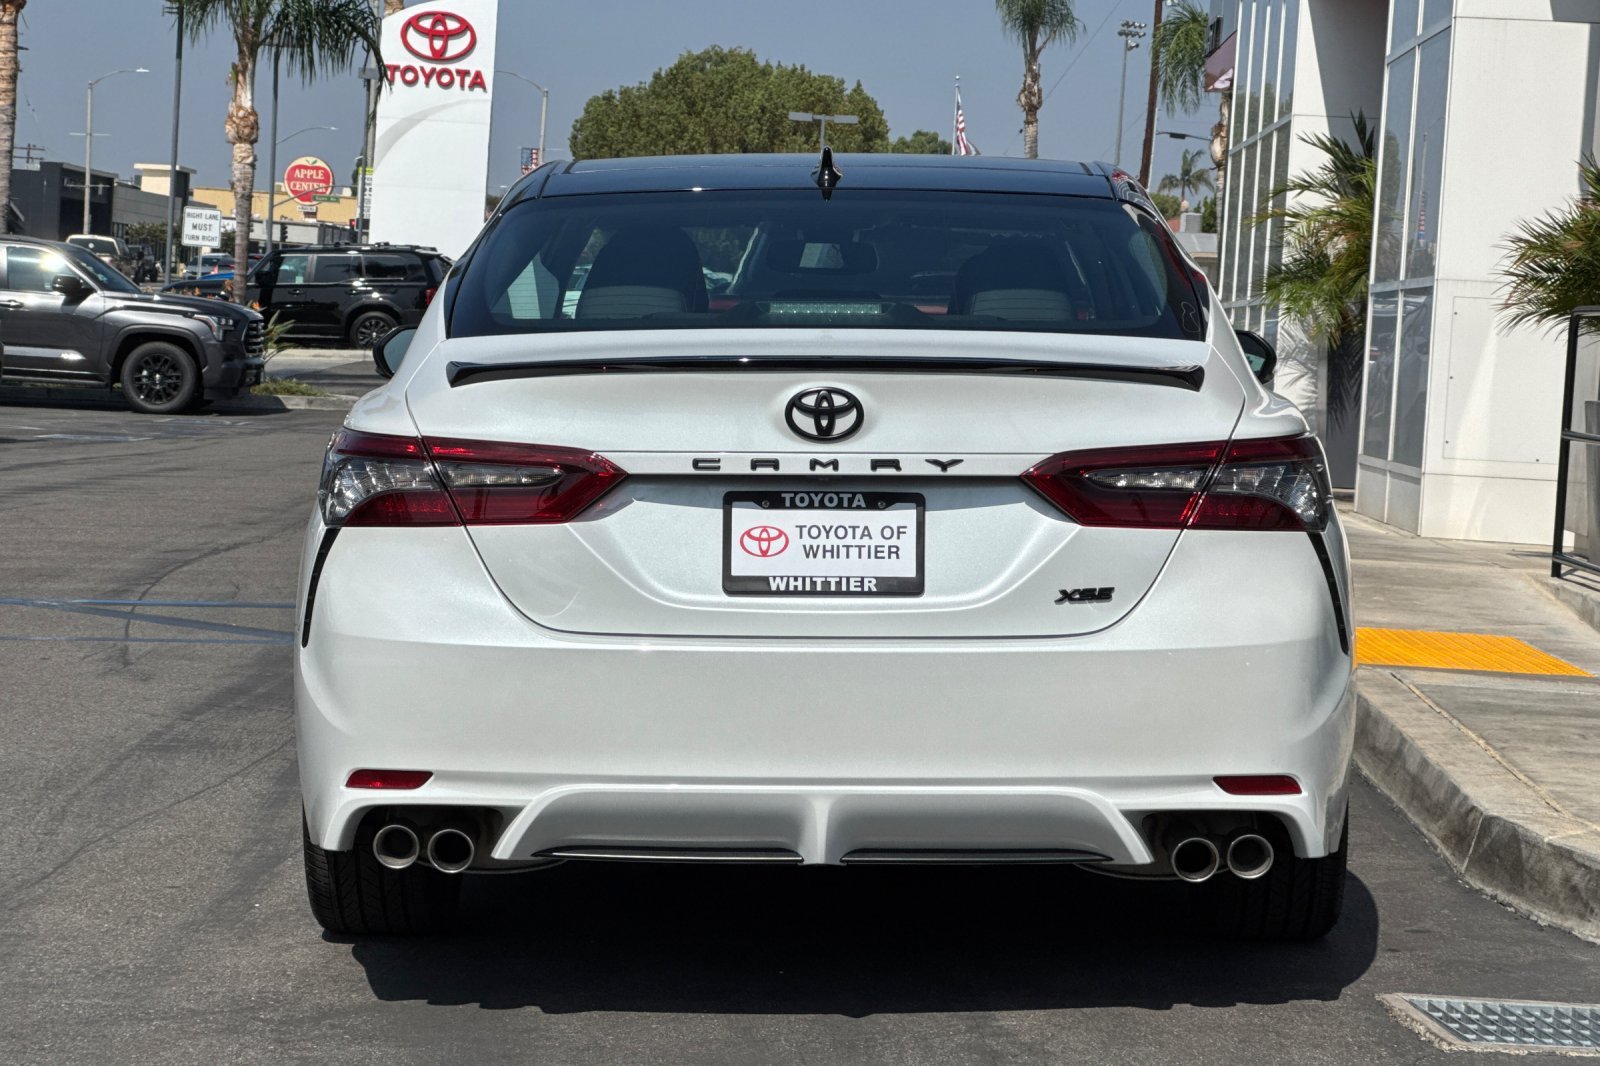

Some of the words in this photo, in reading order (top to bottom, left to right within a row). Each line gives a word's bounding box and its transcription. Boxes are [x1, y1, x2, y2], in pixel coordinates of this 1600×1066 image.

[384, 64, 487, 92] TOYOTA
[294, 169, 325, 180] APPLE
[290, 181, 326, 193] CENTER
[192, 223, 212, 231] MUST
[692, 457, 964, 472] CAMRY
[781, 492, 867, 508] TOYOTA
[795, 525, 873, 540] TOYOTA
[880, 525, 908, 540] OF
[803, 544, 901, 560] WHITTIER
[768, 576, 877, 592] WHITTIER
[1054, 587, 1115, 604] XSE
